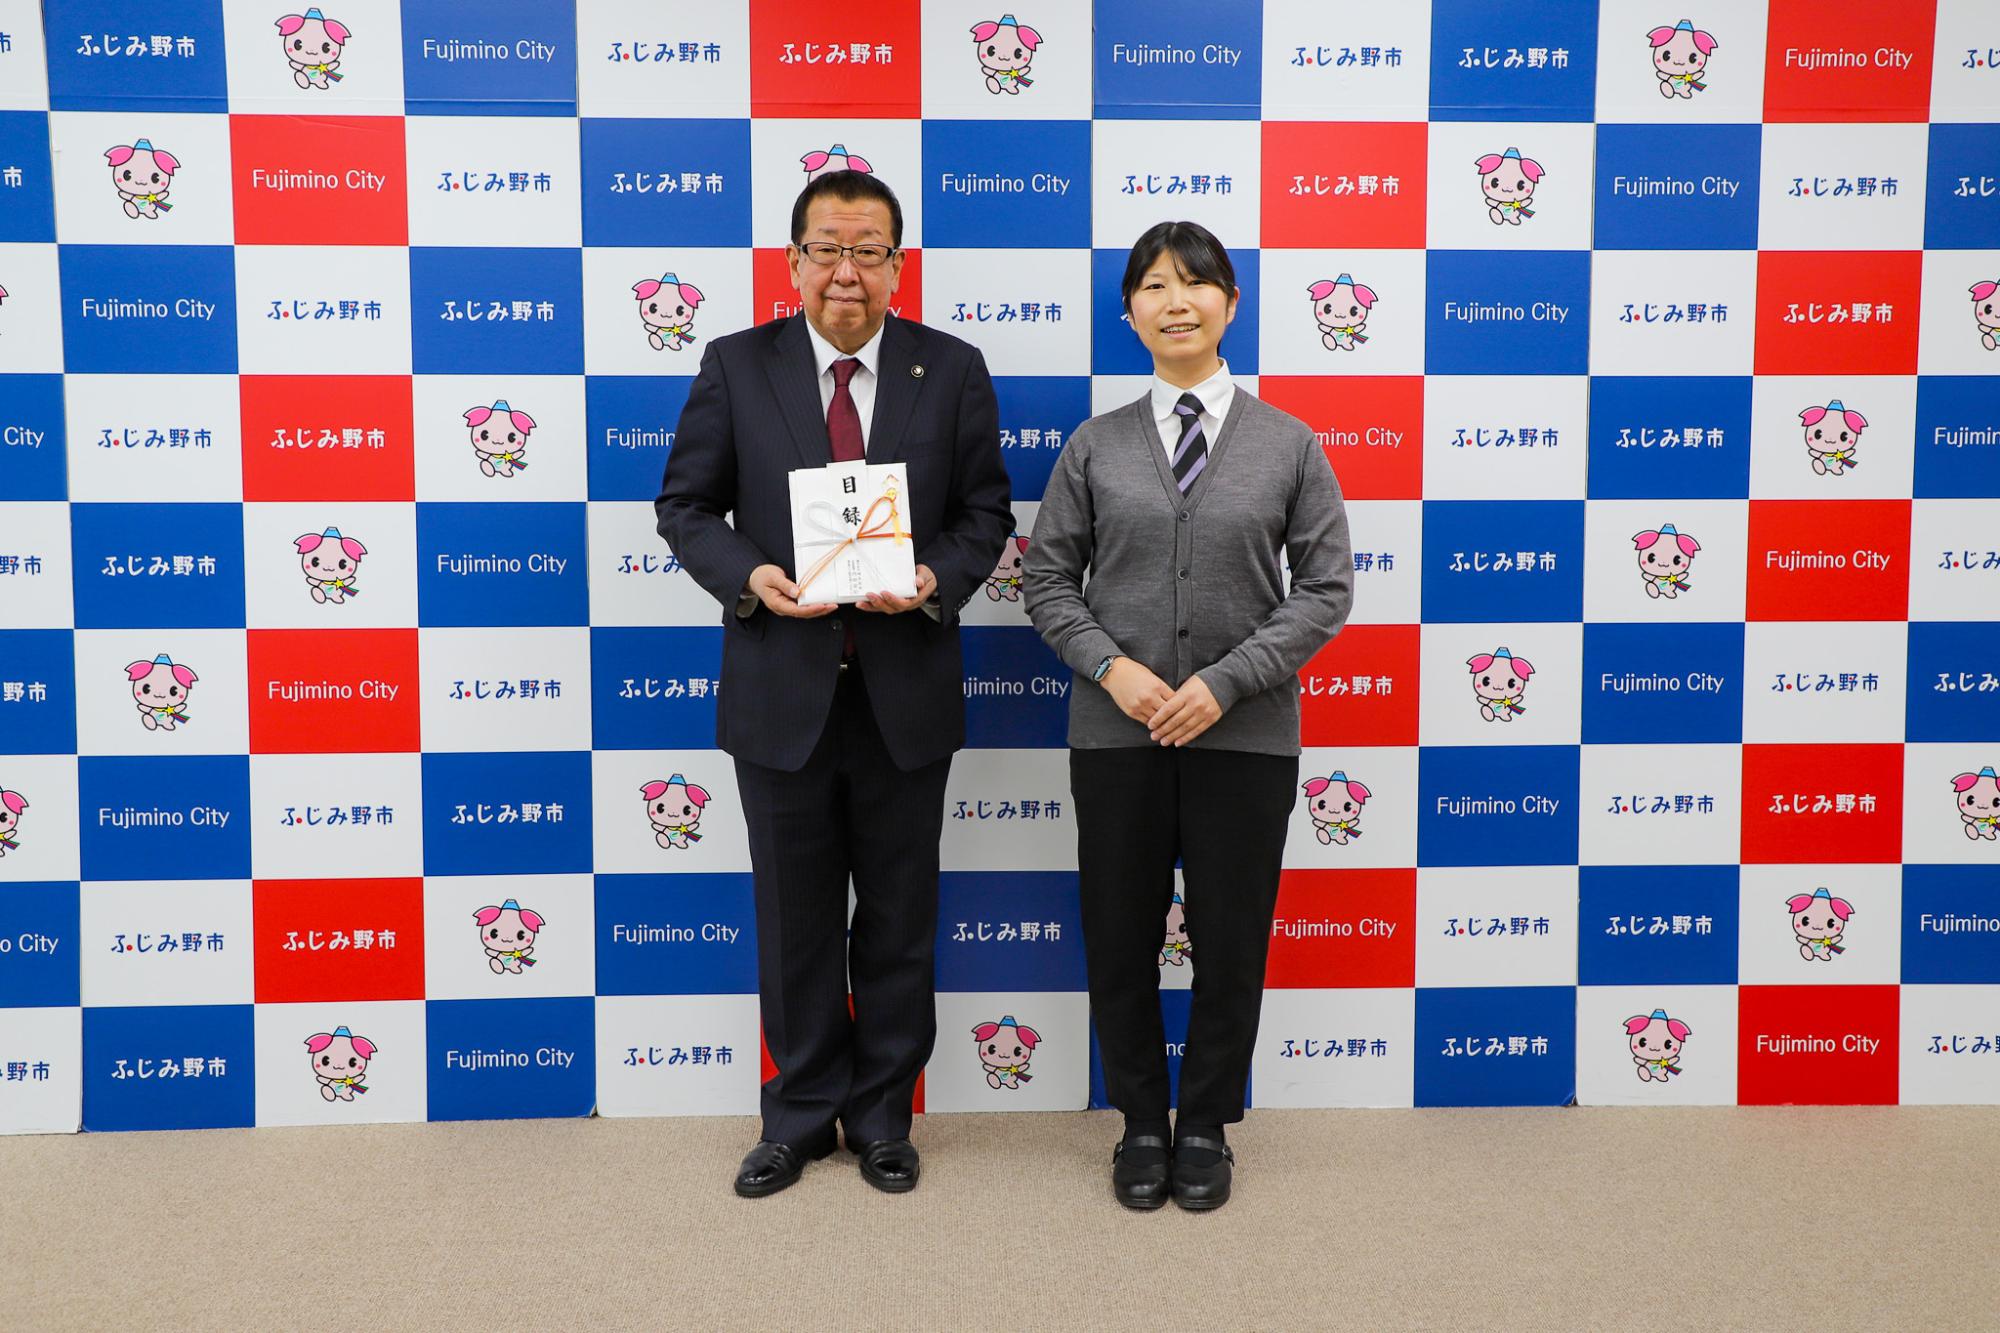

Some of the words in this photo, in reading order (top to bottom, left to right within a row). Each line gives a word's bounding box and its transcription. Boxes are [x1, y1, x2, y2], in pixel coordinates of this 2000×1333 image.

[76, 34, 196, 59] ふじみ野市
[423, 39, 509, 62] Fujimino
[515, 39, 556, 63] City
[607, 41, 721, 64] ふじみ野市
[778, 42, 893, 65] ふじみ野市
[1113, 43, 1196, 67] Fujimino
[1202, 44, 1242, 67] City
[1290, 46, 1403, 68] ふじみ野市
[1458, 47, 1569, 70] ふじみ野市
[1785, 47, 1868, 71] Fujimino
[1874, 47, 1913, 70] City
[252, 169, 339, 192] Fujimino
[345, 169, 386, 193] City
[437, 171, 552, 193] ふじみ野市
[609, 172, 724, 195] ふじみ野市
[941, 173, 1025, 196] Fujimino
[1031, 173, 1071, 196] City
[1121, 174, 1233, 196] ふじみ野市
[1288, 174, 1400, 197] ふじみ野市
[1613, 176, 1695, 198] Fujimino
[1701, 175, 1740, 199] City
[1788, 176, 1899, 198] ふじみ野市
[82, 298, 169, 321] Fujimino
[174, 298, 216, 321] City
[267, 299, 382, 321] ふじみ野市
[440, 300, 555, 323] ふじみ野市
[950, 302, 1063, 324] ふじみ野市
[1444, 301, 1525, 324] Fujimino
[1531, 301, 1569, 324] City
[1619, 303, 1728, 324] ふじみ野市
[1782, 302, 1893, 324] ふじみ野市
[4, 426, 44, 449] City
[97, 427, 212, 449] ふじみ野市
[270, 427, 386, 449] ふじみ野市
[606, 427, 676, 449] Fujimin
[1000, 428, 1062, 449] み野市
[1314, 427, 1359, 446] mino
[1365, 427, 1403, 449] City
[1451, 427, 1559, 448] ふじみ野市
[1615, 427, 1725, 449] ふじみ野市
[842, 475, 862, 526] 目録
[101, 554, 217, 577] ふじみ野市
[437, 553, 522, 576] Fujimino
[527, 553, 568, 576] City
[618, 554, 684, 573] ふじみ
[1448, 551, 1557, 573] ふじみ野市
[1766, 550, 1847, 572] Fujimino
[1852, 549, 1891, 572] City
[268, 680, 353, 703] Fujimino
[358, 679, 399, 702] City
[449, 679, 562, 700] ふじみ野市
[1031, 677, 1069, 698] City
[1300, 676, 1393, 696] じみ野市
[1601, 672, 1681, 695] Fujimino
[1686, 672, 1725, 694] City
[1771, 672, 1879, 693] ふじみ野市
[450, 802, 564, 825] ふじみ野市
[951, 799, 1062, 821] ふじみ野市
[1436, 795, 1517, 818] Fujimino
[1522, 795, 1560, 816] City
[1607, 794, 1714, 815] ふじみ野市
[1768, 793, 1877, 815] ふじみ野市
[98, 807, 184, 830] Fujimino
[189, 806, 230, 829] City
[280, 805, 394, 827] ふじみ野市
[613, 923, 695, 946] Fujimino
[701, 923, 740, 945] City
[952, 921, 1062, 942] ふじみ野市
[1272, 918, 1353, 940] Fujimino
[1358, 918, 1397, 939] City
[1443, 916, 1550, 937] ふじみ野市
[1604, 914, 1713, 936] ふじみ野市
[1920, 913, 2000, 935] Fujimino
[19, 933, 59, 955] City
[110, 932, 225, 954] ふじみ野市
[281, 928, 397, 952] ふじみ野市
[1279, 1038, 1388, 1059] ふじみ野市
[1441, 1035, 1549, 1057] ふじみ野市
[1756, 1034, 1837, 1056] Fujimino
[1842, 1034, 1880, 1056] City
[1927, 1035, 2000, 1054] ふじみ
[446, 1048, 530, 1071] Fujimino
[535, 1047, 575, 1069] City
[623, 1045, 733, 1067] ふじみ野市
[0, 1061, 50, 1081] 野市
[111, 1056, 227, 1080] ふじみ野市
